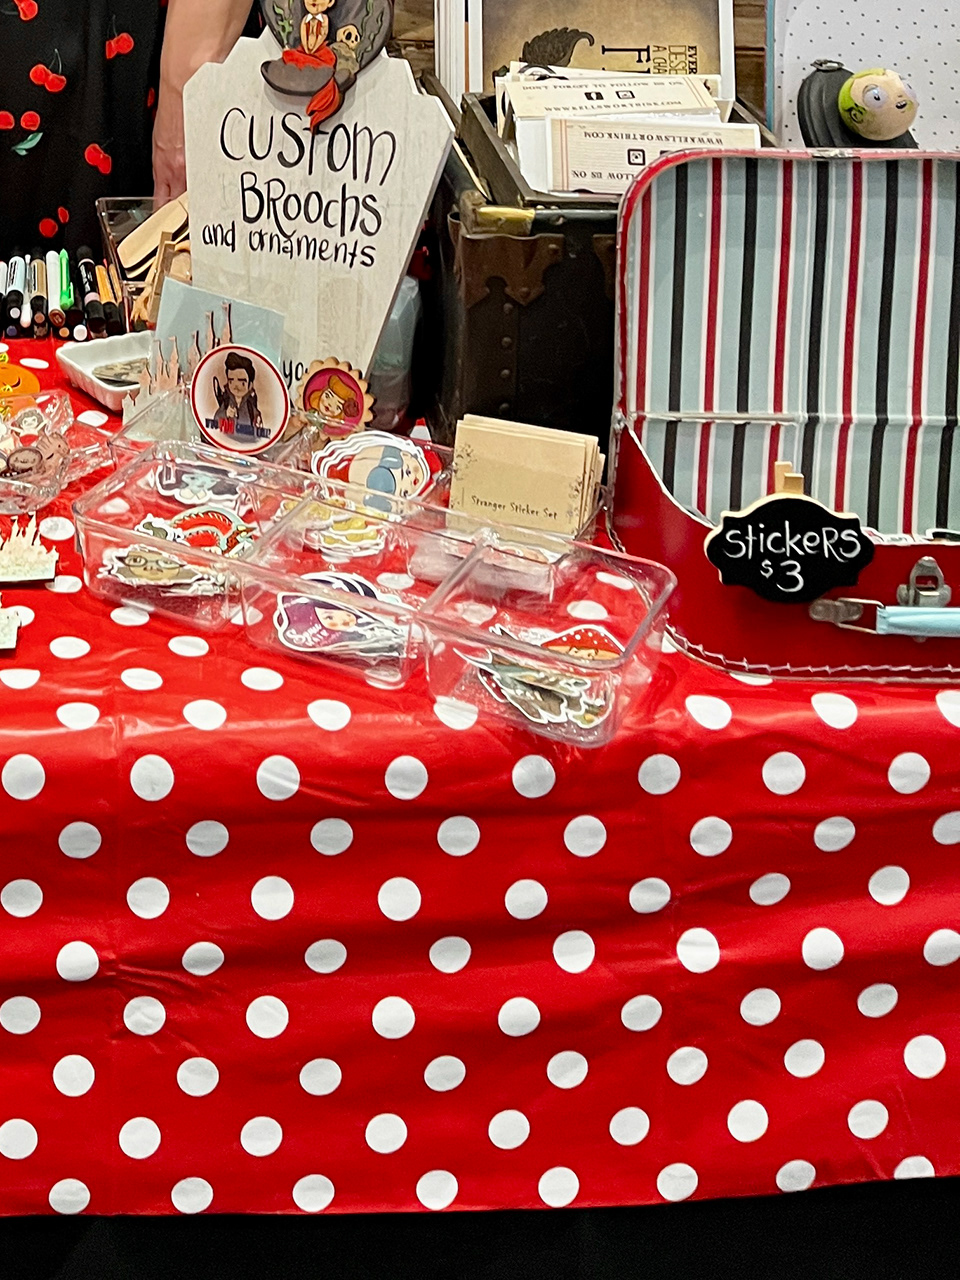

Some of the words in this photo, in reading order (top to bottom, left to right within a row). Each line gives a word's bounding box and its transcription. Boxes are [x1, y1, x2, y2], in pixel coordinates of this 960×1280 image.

[652, 57, 667, 74] CHA
[668, 45, 687, 74] DESE
[688, 45, 697, 74] EVER
[607, 172, 635, 181] LLOW
[202, 220, 236, 253] and
[249, 229, 376, 268] ornaments
[283, 360, 308, 390] yo
[472, 495, 506, 511] Stranger
[510, 502, 539, 516] Sticker
[544, 507, 557, 520] Set
[760, 560, 804, 592] $3
